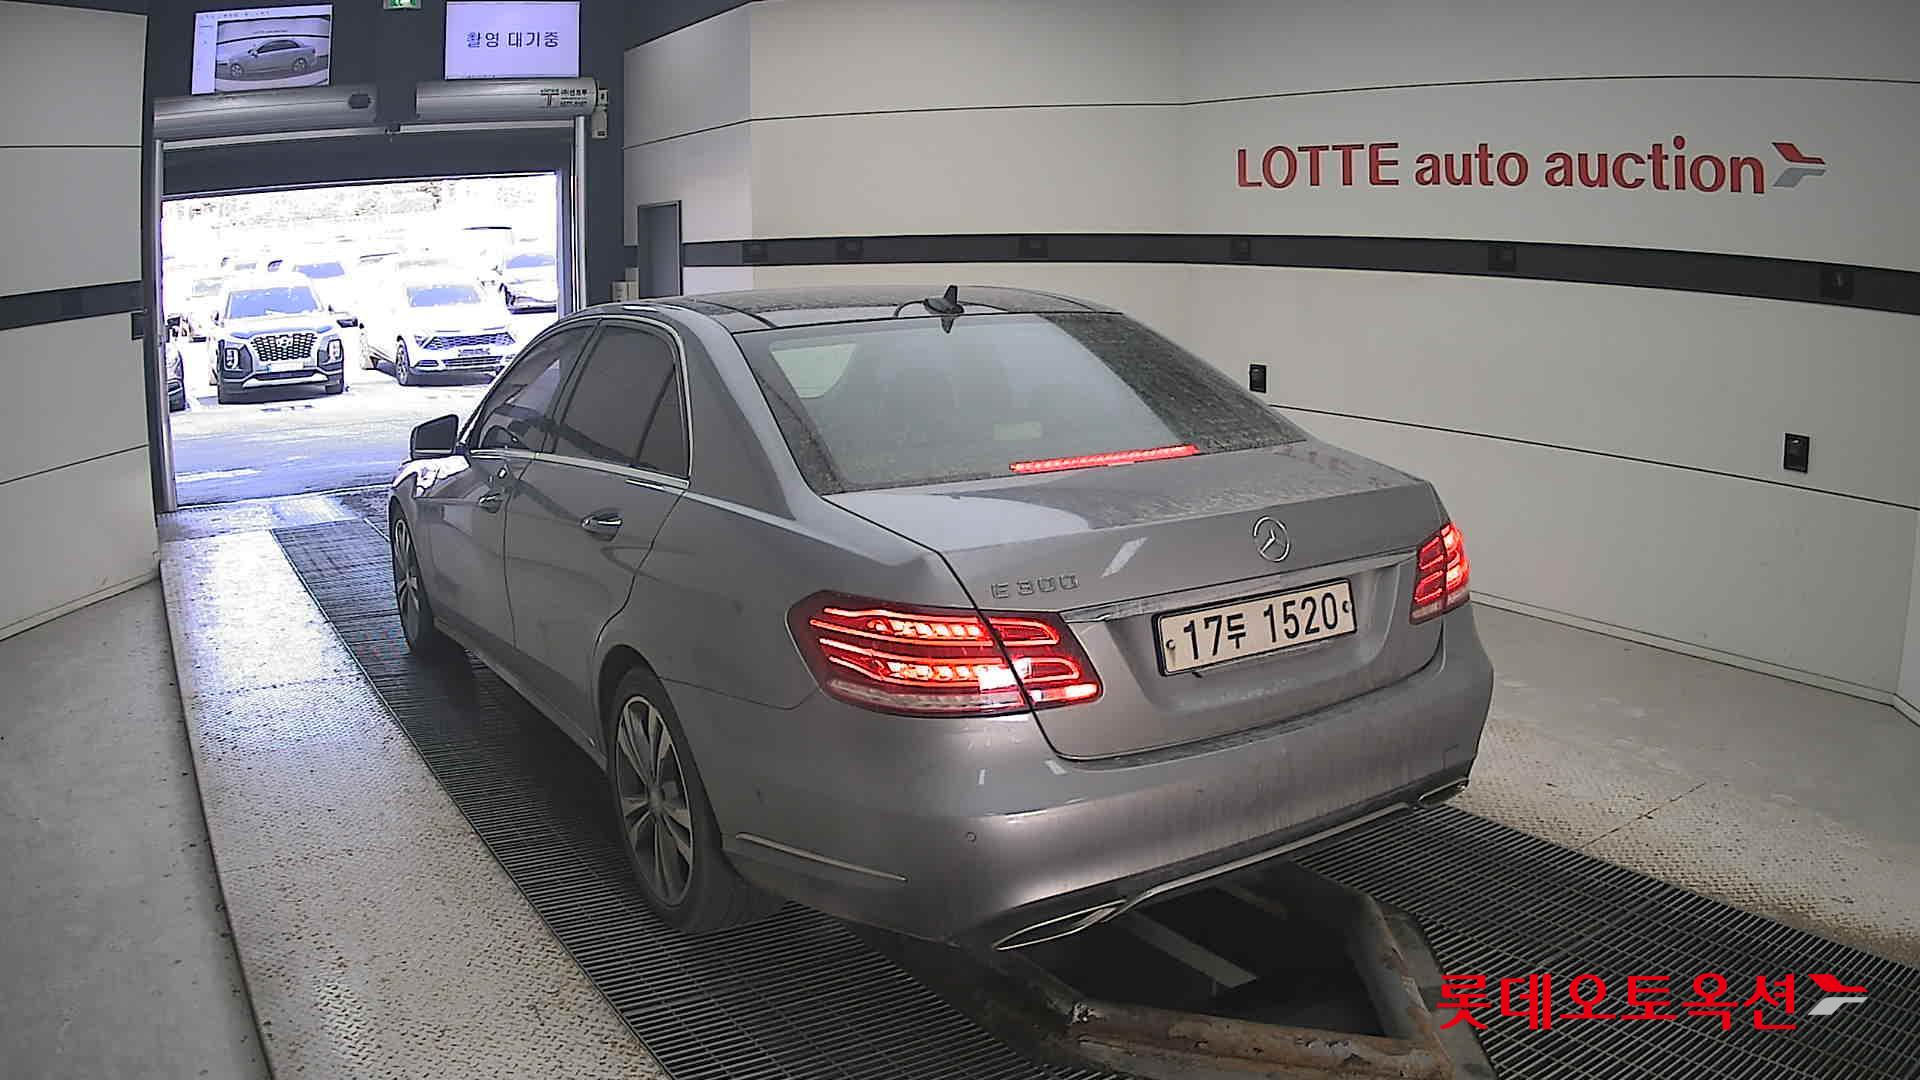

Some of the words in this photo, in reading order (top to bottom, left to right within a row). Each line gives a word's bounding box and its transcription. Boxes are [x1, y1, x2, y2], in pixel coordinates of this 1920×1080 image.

[508, 31, 559, 48] 대기중
[1237, 143, 1400, 189] LOTTE
[1415, 144, 1528, 187] auto
[1546, 136, 1765, 193] auction
[991, 582, 1009, 600] E
[1184, 613, 1249, 660] 17두
[1263, 592, 1339, 644] 1520
